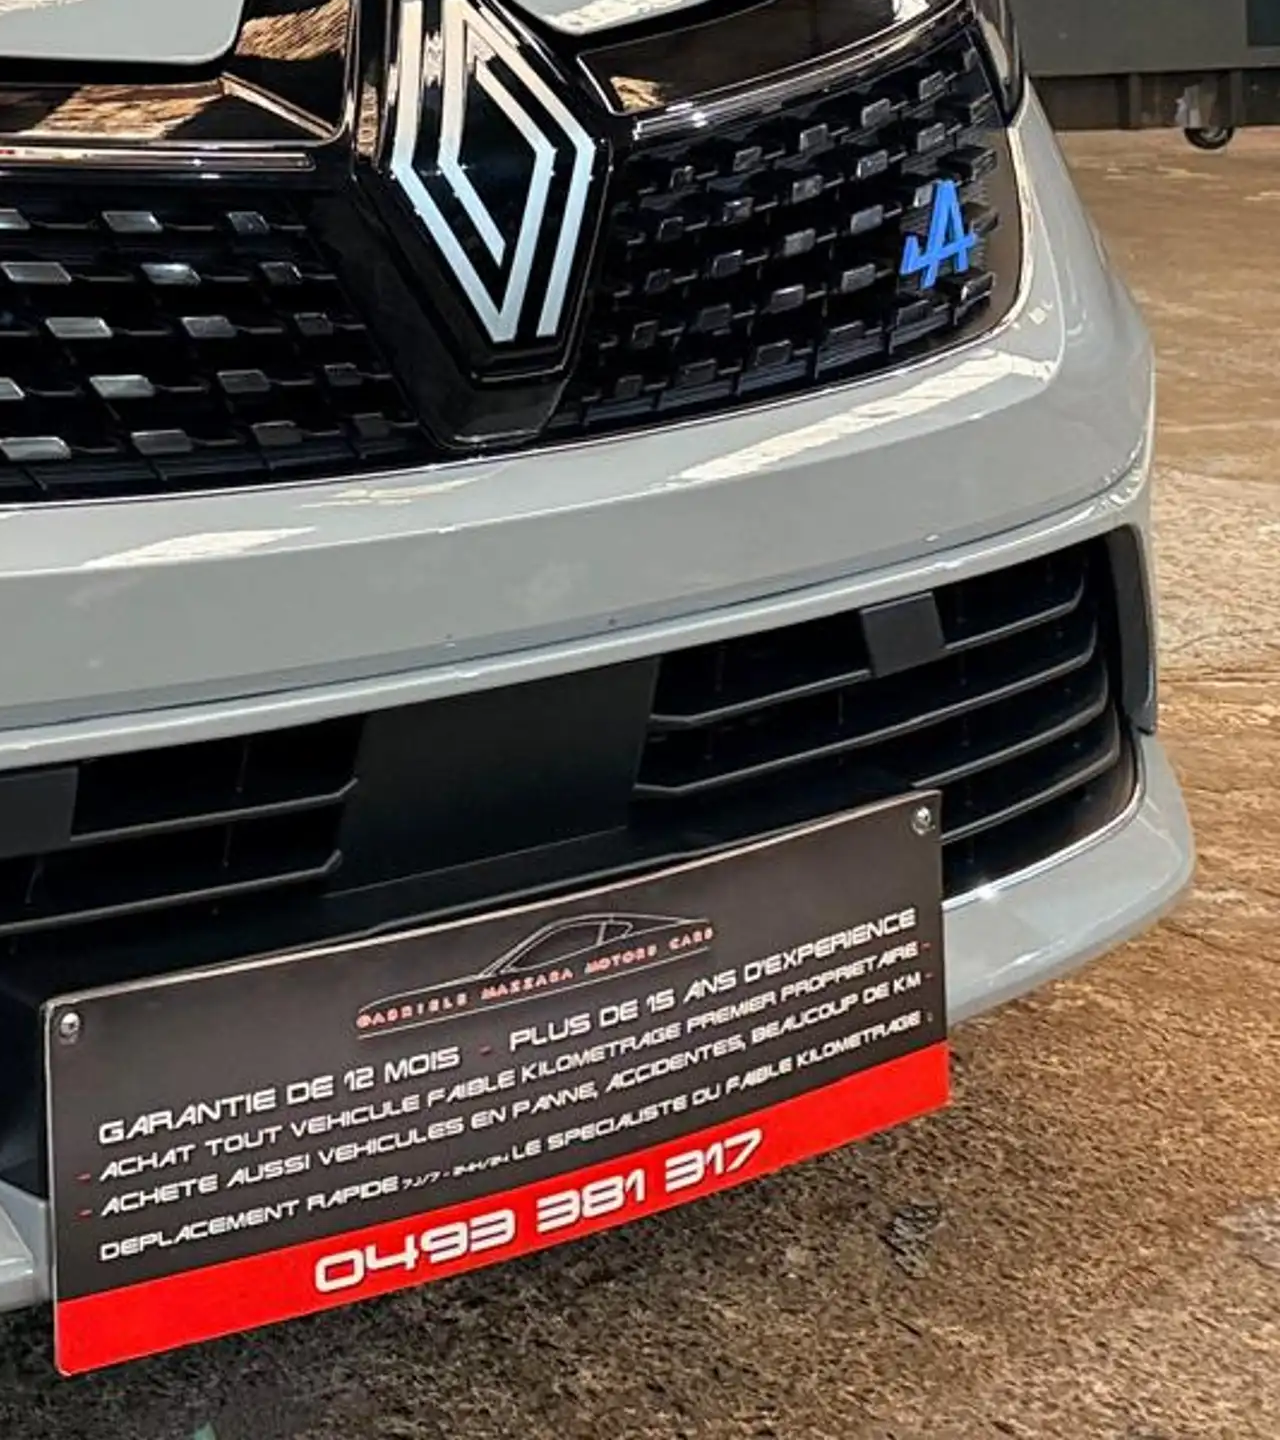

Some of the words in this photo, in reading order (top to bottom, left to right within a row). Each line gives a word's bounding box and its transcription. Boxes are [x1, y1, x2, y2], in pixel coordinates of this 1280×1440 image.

[98, 1088, 277, 1145] GARANTIE
[286, 1075, 335, 1106] DE
[344, 1067, 374, 1093] 12
[384, 1047, 460, 1083] MOIS
[509, 1011, 591, 1051] PLUS
[599, 1000, 639, 1029] DE
[646, 990, 676, 1016] 15
[683, 969, 737, 1003] ANS
[744, 909, 917, 982] D'EXPERIENCE
[99, 1144, 196, 1182] ACHAT
[205, 1124, 282, 1156] TOUT
[291, 1094, 420, 1137] VEHICULE
[427, 1070, 516, 1108] FAIBLE
[521, 1018, 681, 1082] KILOMETRAGE
[687, 992, 776, 1032] PREMIER
[780, 942, 919, 1002] PROPRIETAIRE
[100, 1200, 299, 1261] DEPLACEMENT
[308, 1176, 399, 1211] RAPIDE
[512, 1140, 541, 1160] LE
[548, 1092, 687, 1152] SPECIALISTE
[693, 1080, 720, 1101] DU
[726, 1058, 792, 1094] FAIBLE
[797, 1011, 921, 1069] KILOMETRAGE
[101, 1175, 218, 1217] ACHETE
[227, 1153, 310, 1188] AUSSI
[319, 1117, 464, 1165] VEHICULES
[471, 1107, 506, 1130] EN
[751, 994, 859, 1044] BEAUCOUP
[863, 982, 890, 1003] DE
[893, 972, 921, 992] KM
[315, 1209, 516, 1292] 0493
[537, 1169, 646, 1233] 381
[665, 1128, 764, 1192] 317
